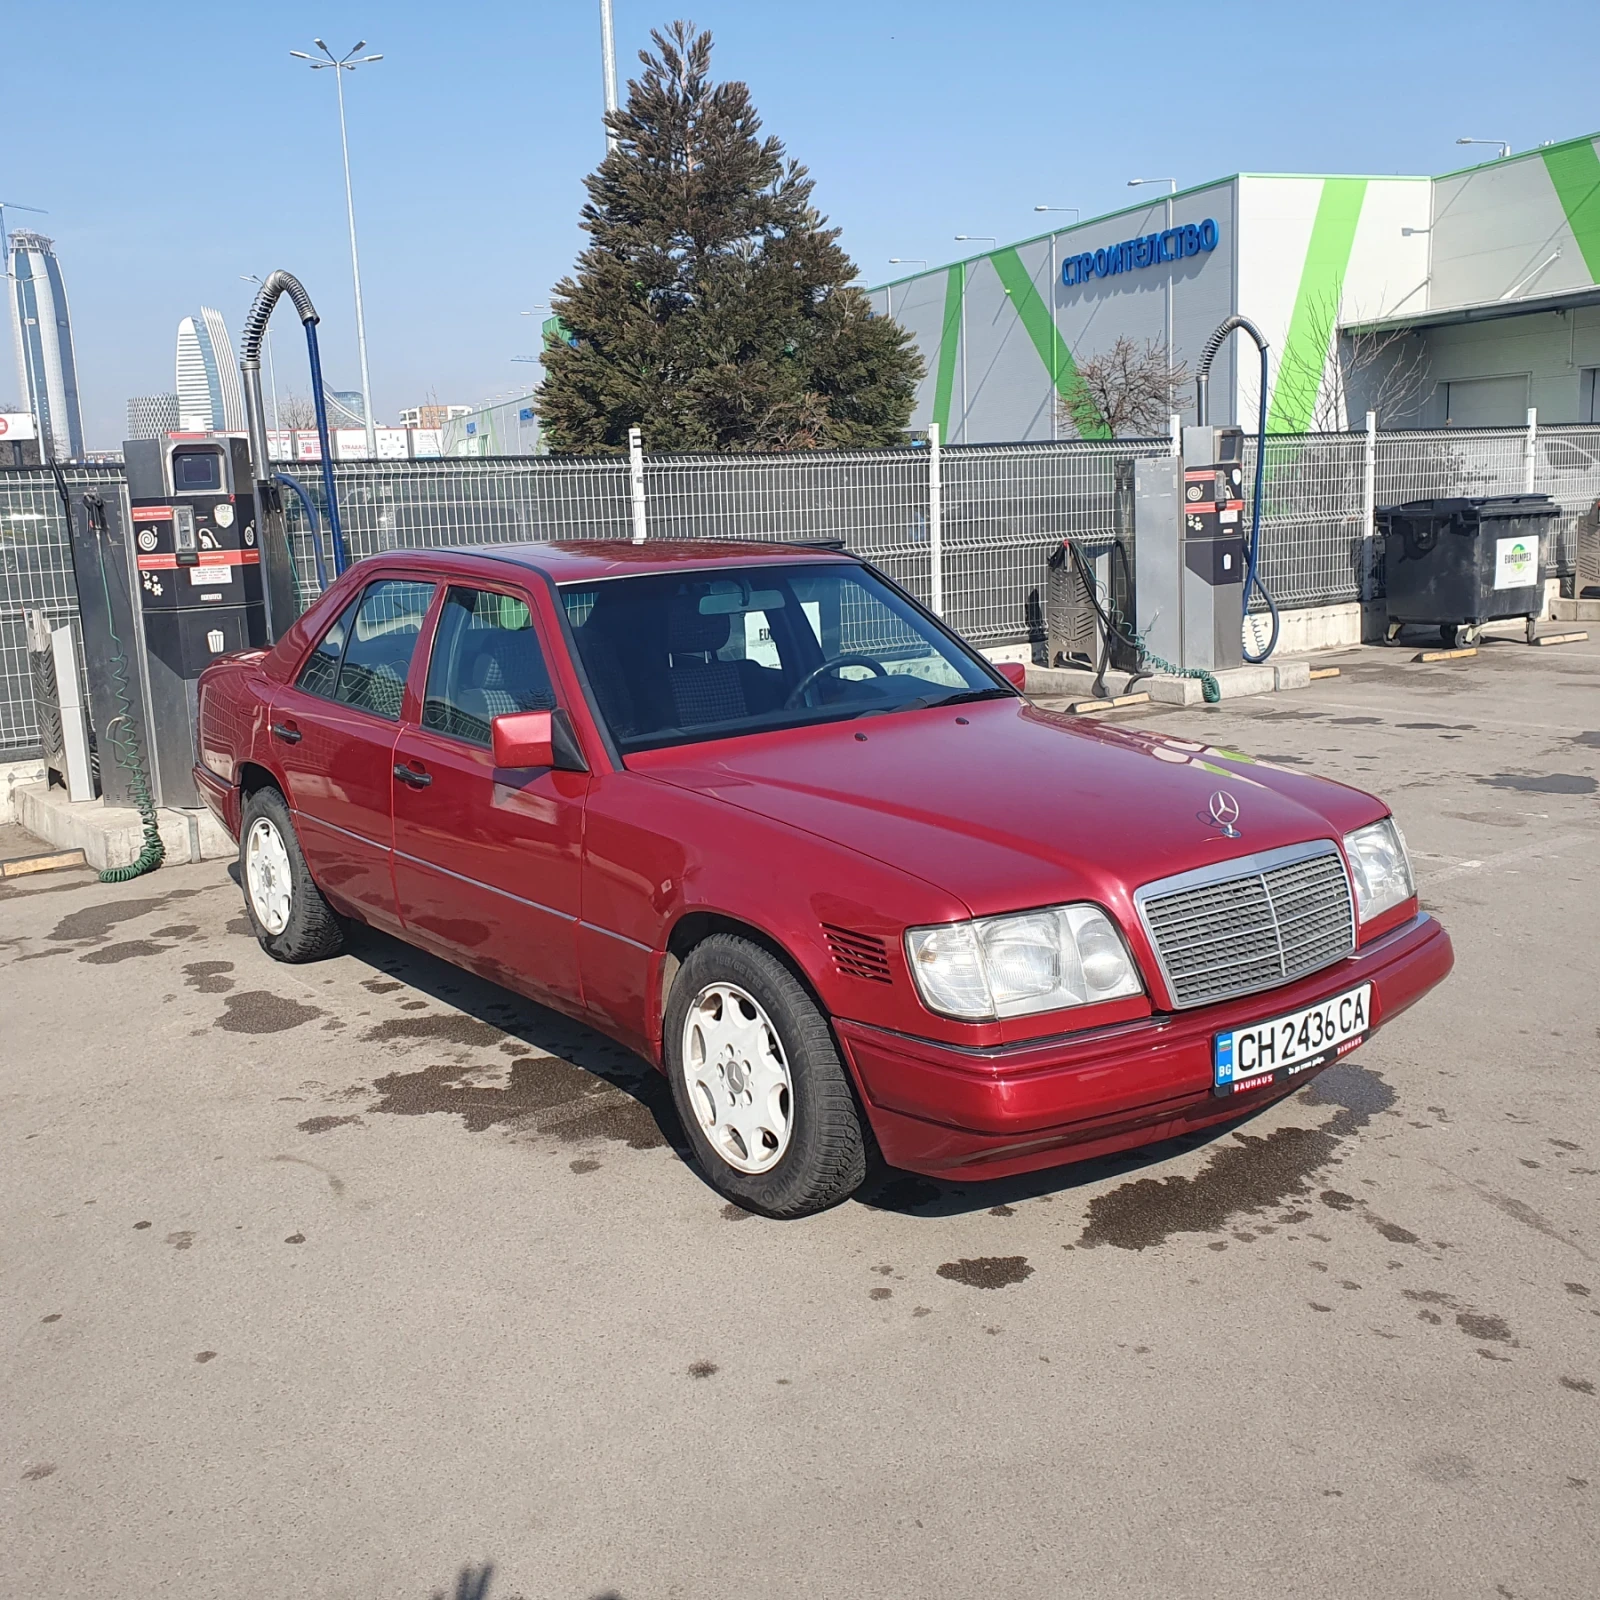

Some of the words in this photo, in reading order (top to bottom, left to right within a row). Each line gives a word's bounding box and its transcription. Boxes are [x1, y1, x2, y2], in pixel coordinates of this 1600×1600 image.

[1062, 217, 1219, 286] СТРОИТЕЛСТВО
[229, 494, 236, 502] 2
[1504, 552, 1532, 564] EUROIMPEX
[1281, 1005, 1335, 1060] 2436
[1336, 1036, 1363, 1055] BAUHAUS
[1218, 1064, 1231, 1077] BG
[1233, 1073, 1273, 1092] BAUHAUS
